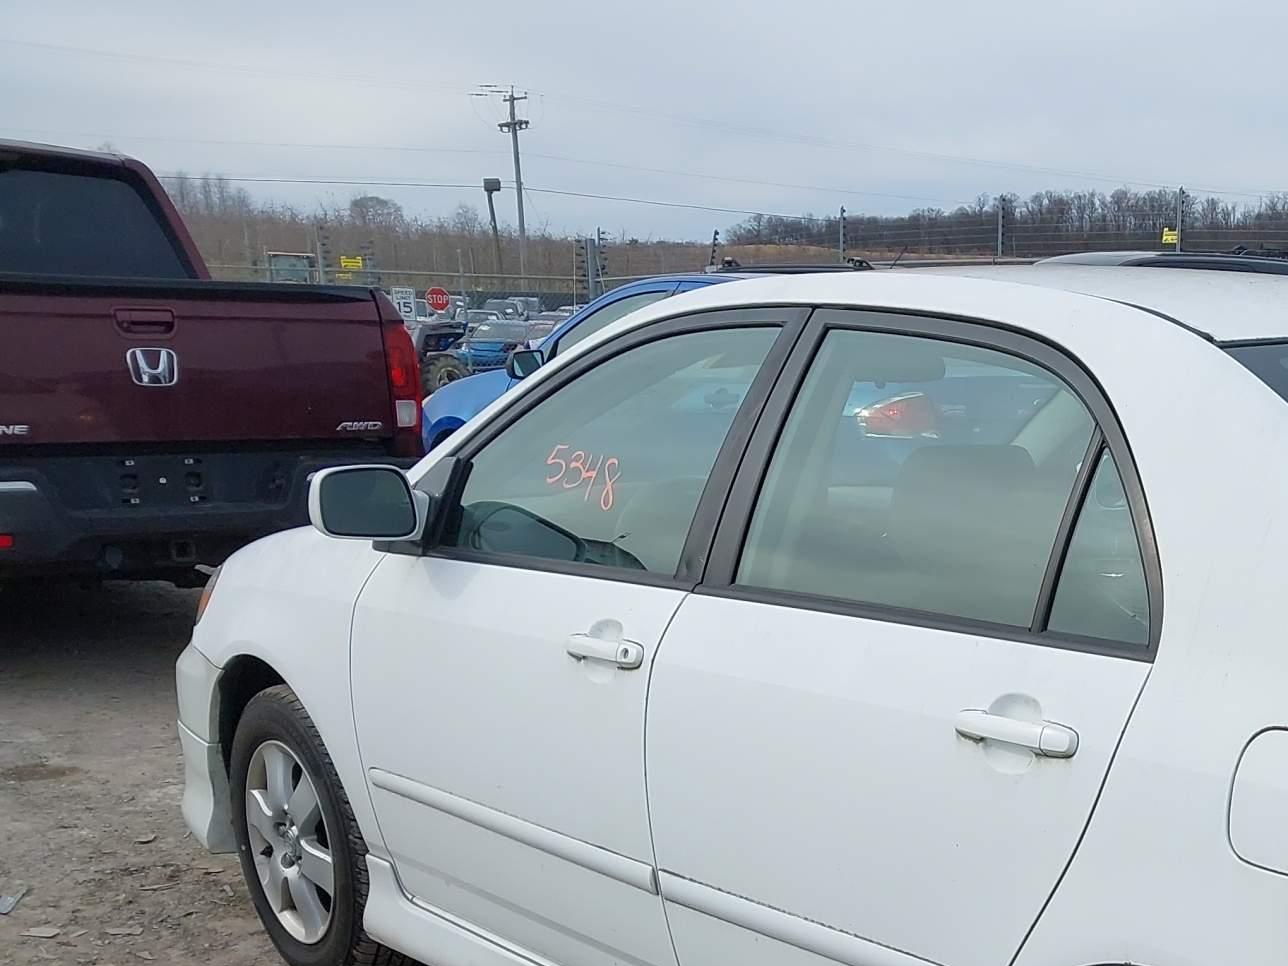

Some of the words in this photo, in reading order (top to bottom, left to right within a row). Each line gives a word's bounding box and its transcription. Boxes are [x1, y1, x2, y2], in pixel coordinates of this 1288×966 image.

[427, 295, 448, 304] STOP
[397, 302, 413, 313] 15
[336, 421, 382, 431] AWD
[545, 444, 621, 511] 5348
